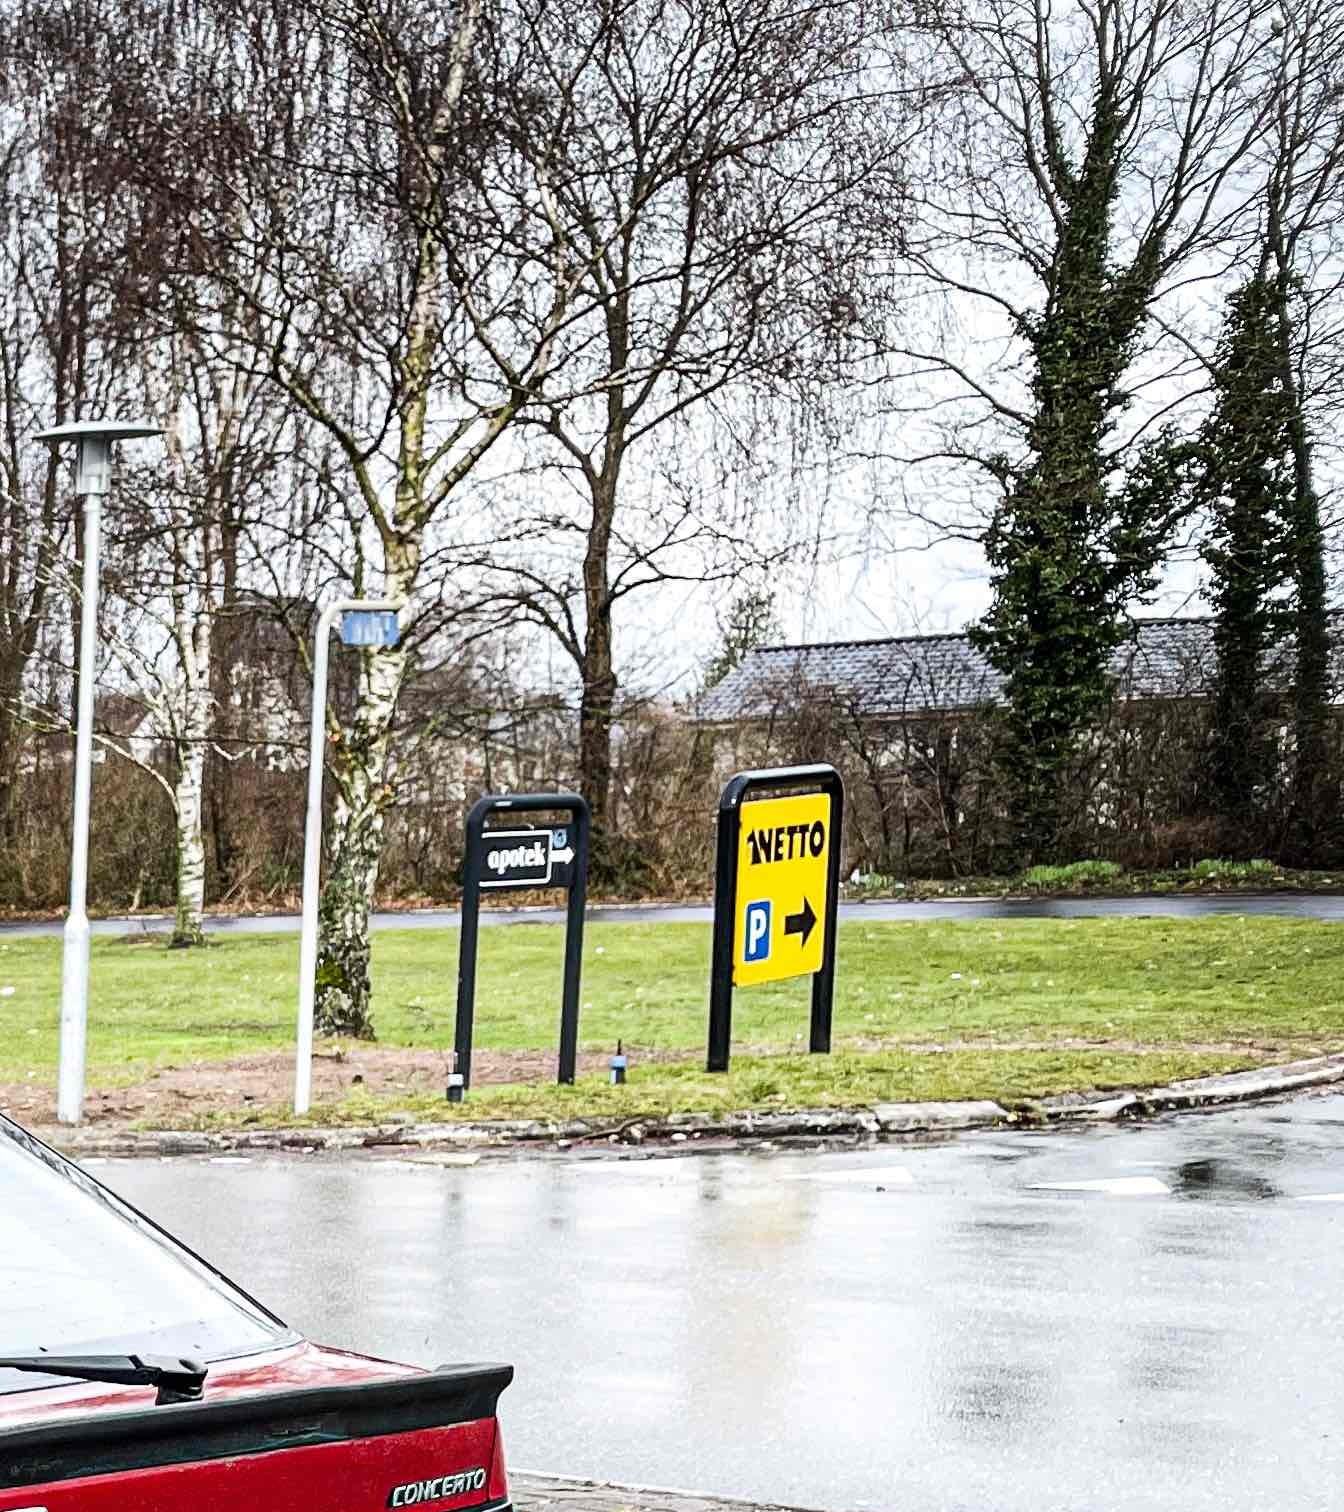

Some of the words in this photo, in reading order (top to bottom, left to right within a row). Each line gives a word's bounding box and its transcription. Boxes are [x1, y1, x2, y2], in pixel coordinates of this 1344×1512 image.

[487, 841, 547, 875] apotek
[747, 820, 825, 865] NETTO
[748, 909, 767, 955] P
[393, 1467, 487, 1507] CONCERTO
